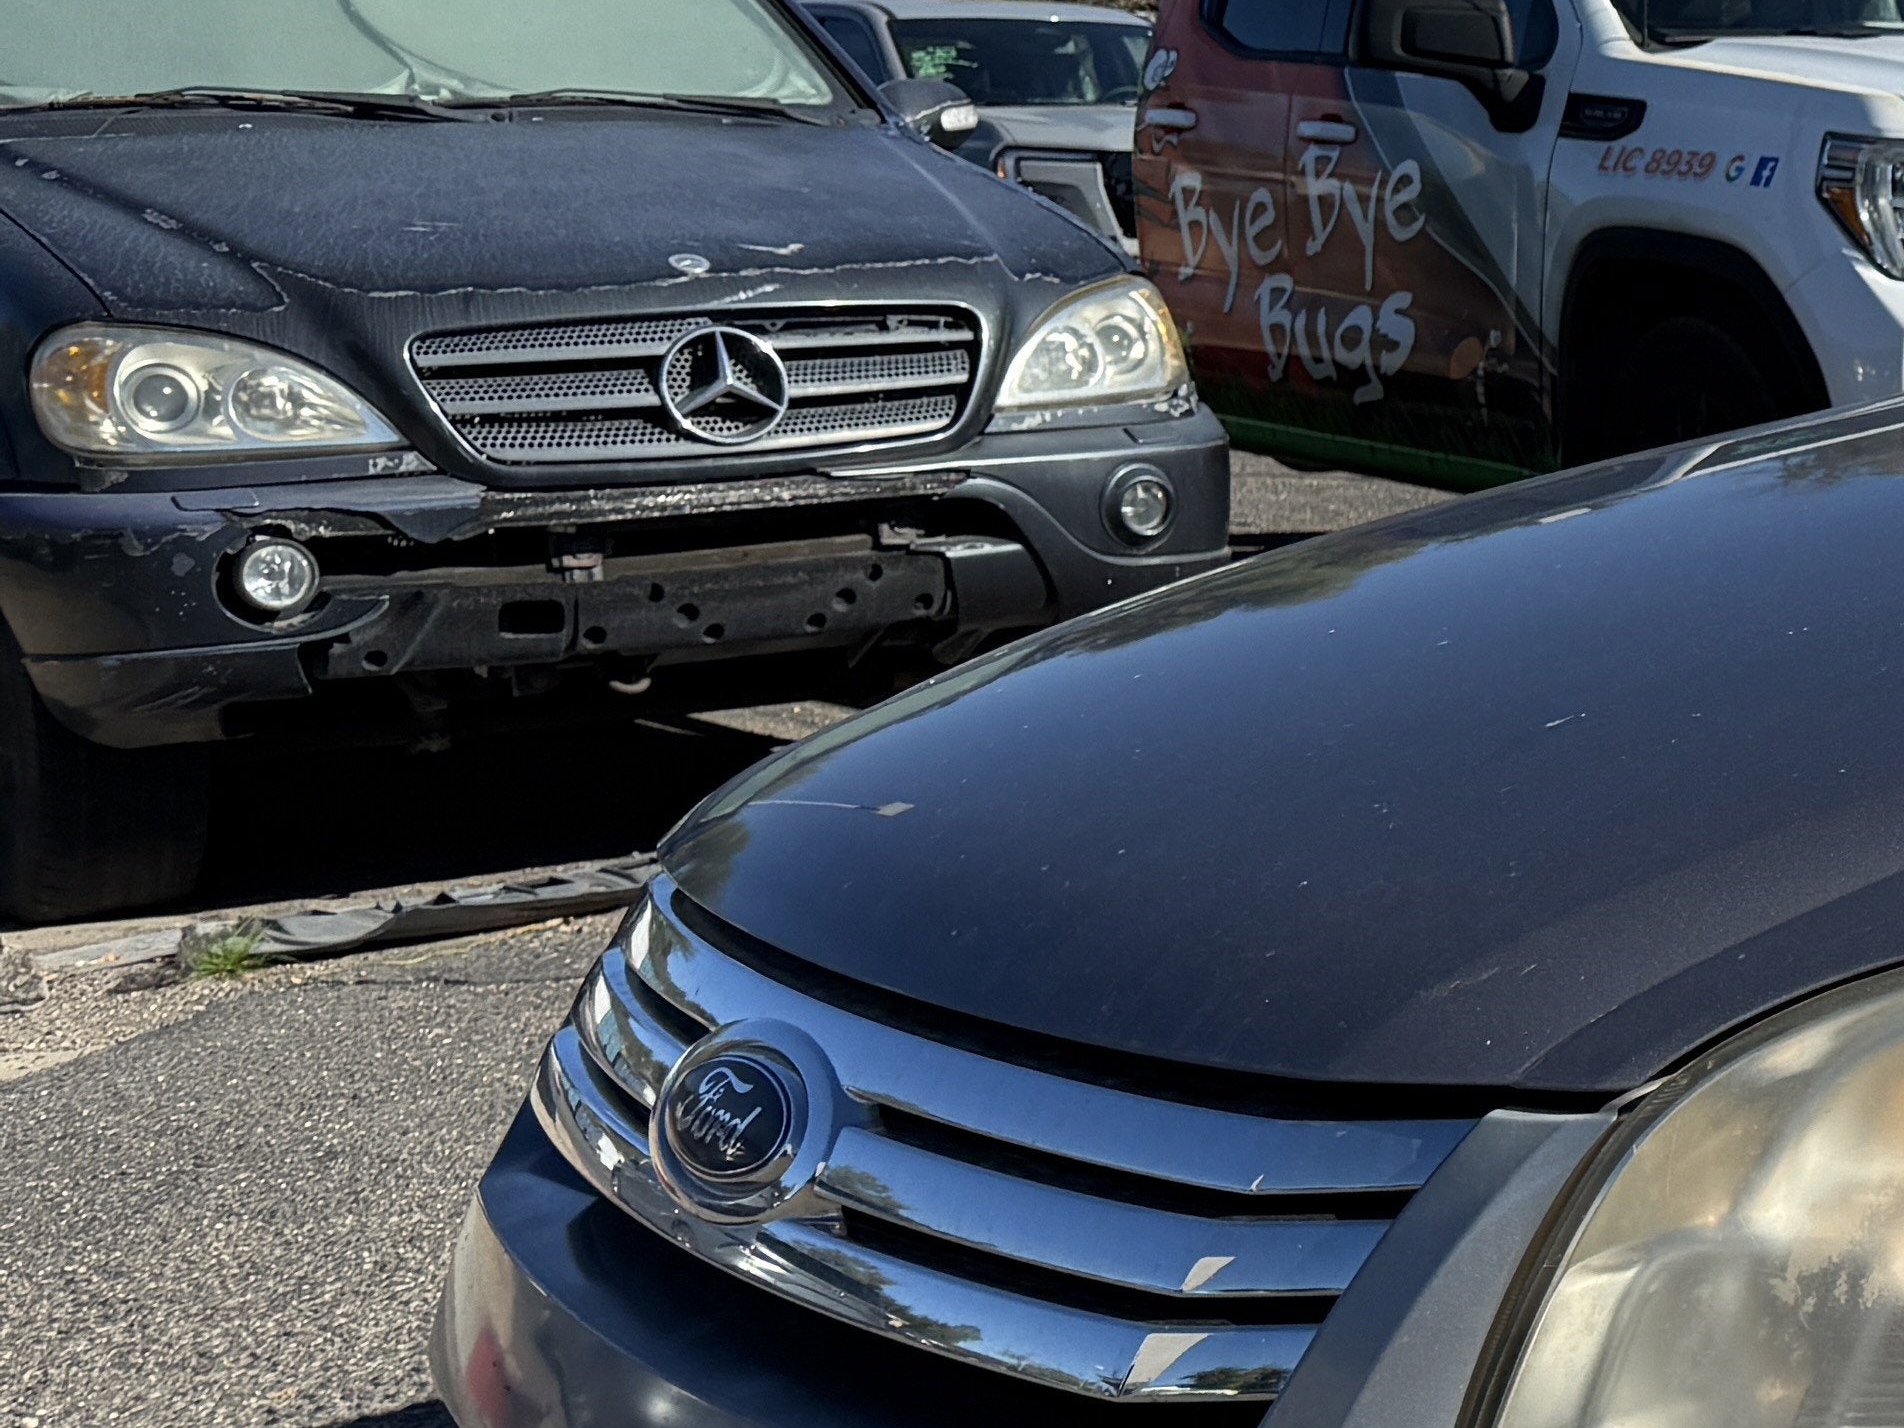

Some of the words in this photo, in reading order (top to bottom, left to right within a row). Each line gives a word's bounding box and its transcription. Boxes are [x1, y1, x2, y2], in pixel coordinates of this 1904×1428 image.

[1168, 171, 1282, 314] Bye
[1299, 142, 1426, 292] Bye
[1598, 146, 1645, 175] LIC
[1645, 148, 1717, 179] 8939
[1253, 273, 1416, 406] Bugs
